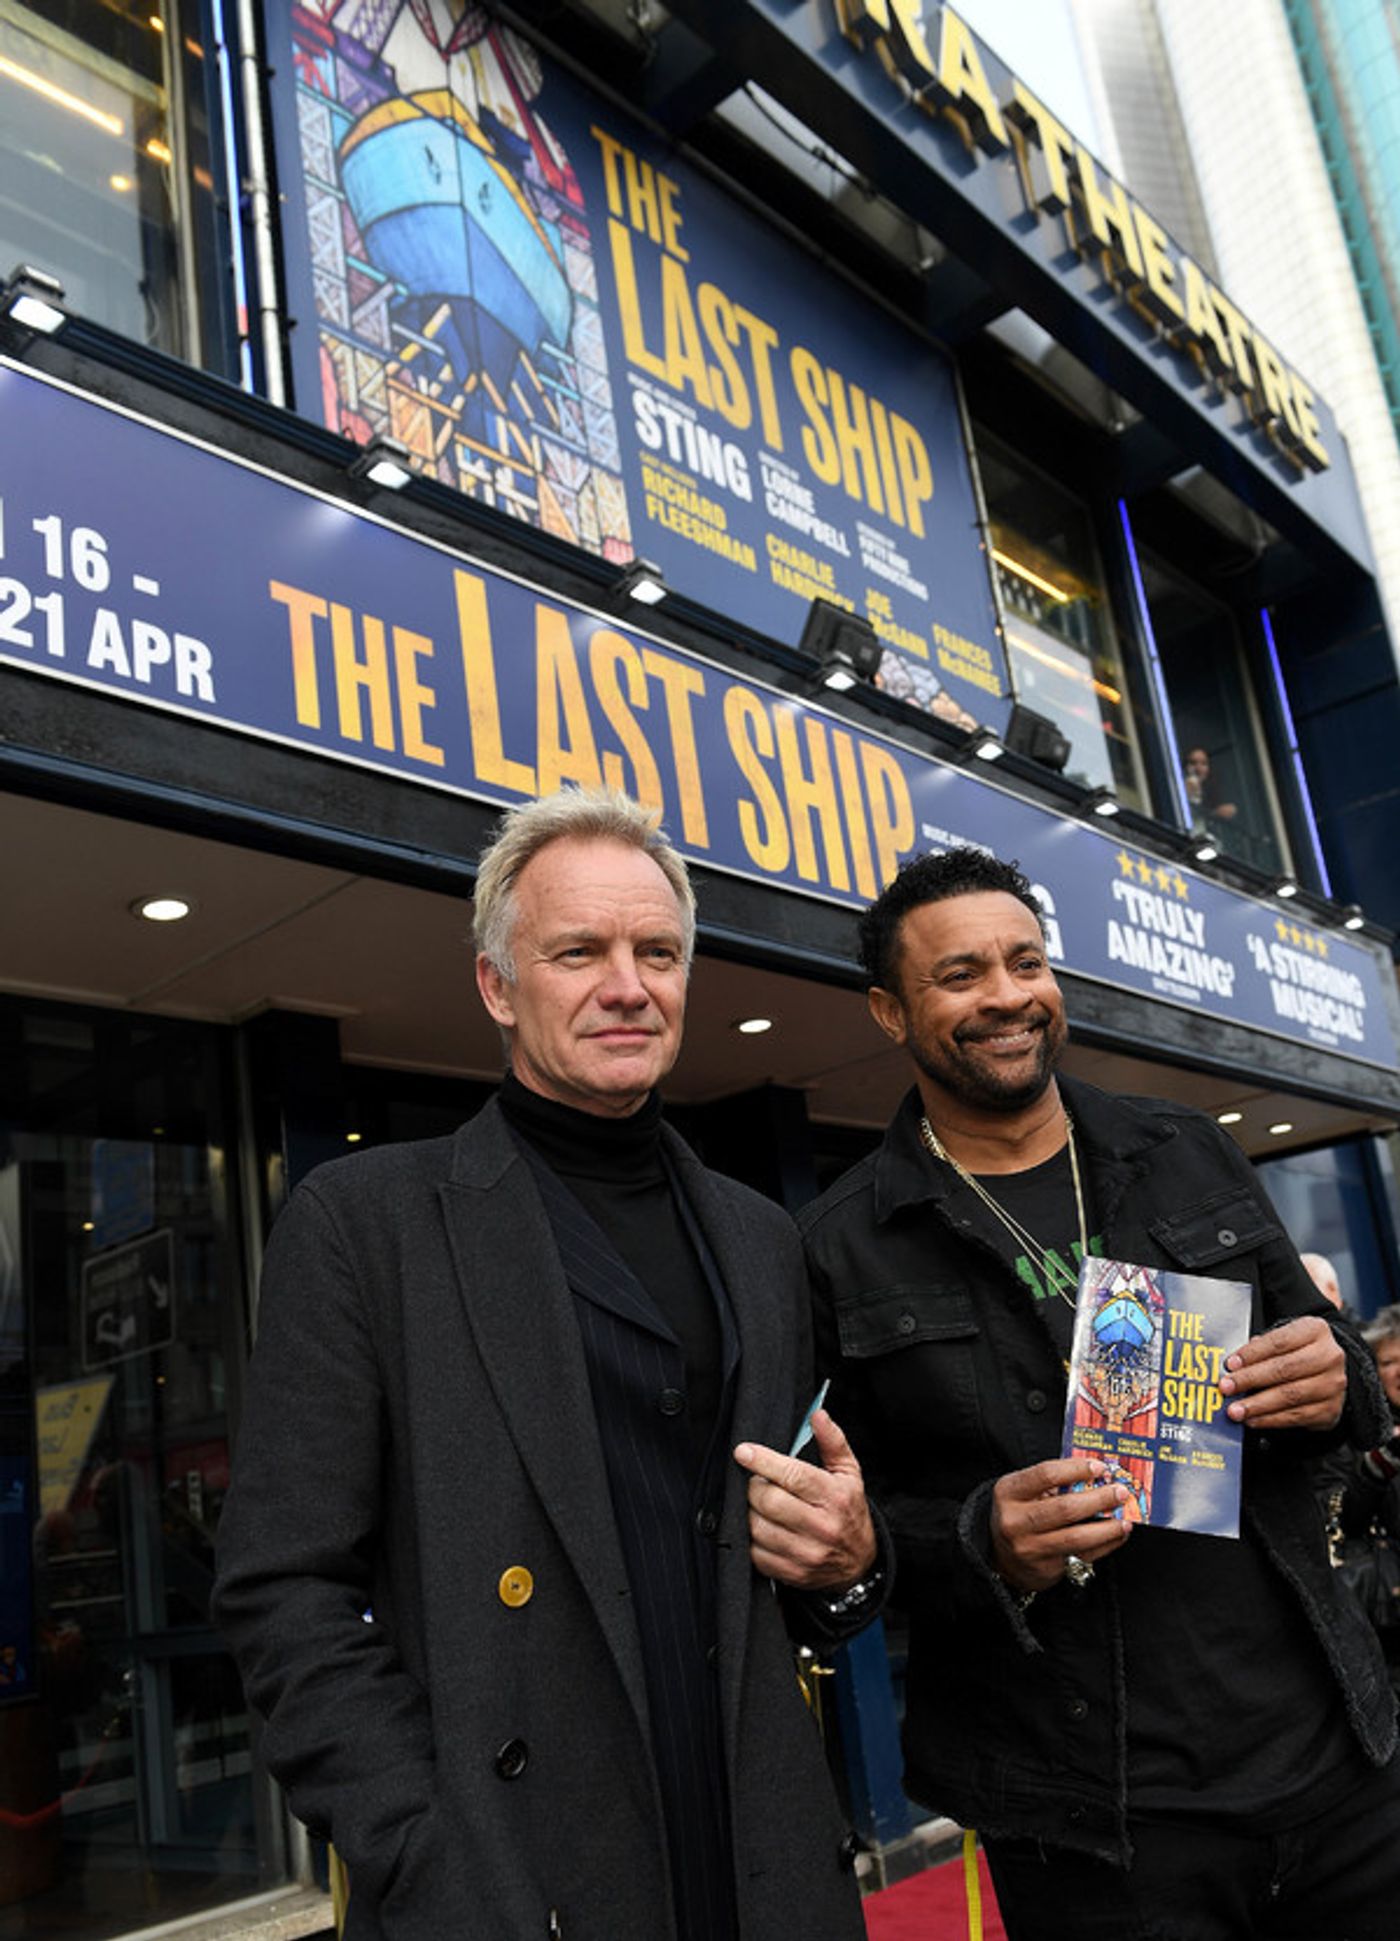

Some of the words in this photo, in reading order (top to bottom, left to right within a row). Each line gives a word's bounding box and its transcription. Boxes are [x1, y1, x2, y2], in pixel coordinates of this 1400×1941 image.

[591, 125, 690, 262] THE
[1011, 78, 1330, 470] THEATRE
[608, 218, 783, 452] LAST
[789, 346, 934, 539] SHIP
[632, 389, 753, 502] STING
[641, 464, 727, 530] RICHARD
[645, 493, 757, 572] FLEESHMAN
[765, 491, 851, 557] CAMPBELL
[32, 514, 110, 592] 16
[0, 576, 66, 658] 21
[87, 607, 216, 704] APR
[269, 580, 445, 768] THE
[453, 568, 709, 850] LAST
[722, 685, 916, 902] SHIP
[1163, 1339, 1225, 1384] LAST
[1168, 1309, 1205, 1342] THE
[1161, 1378, 1224, 1424] SHIP
